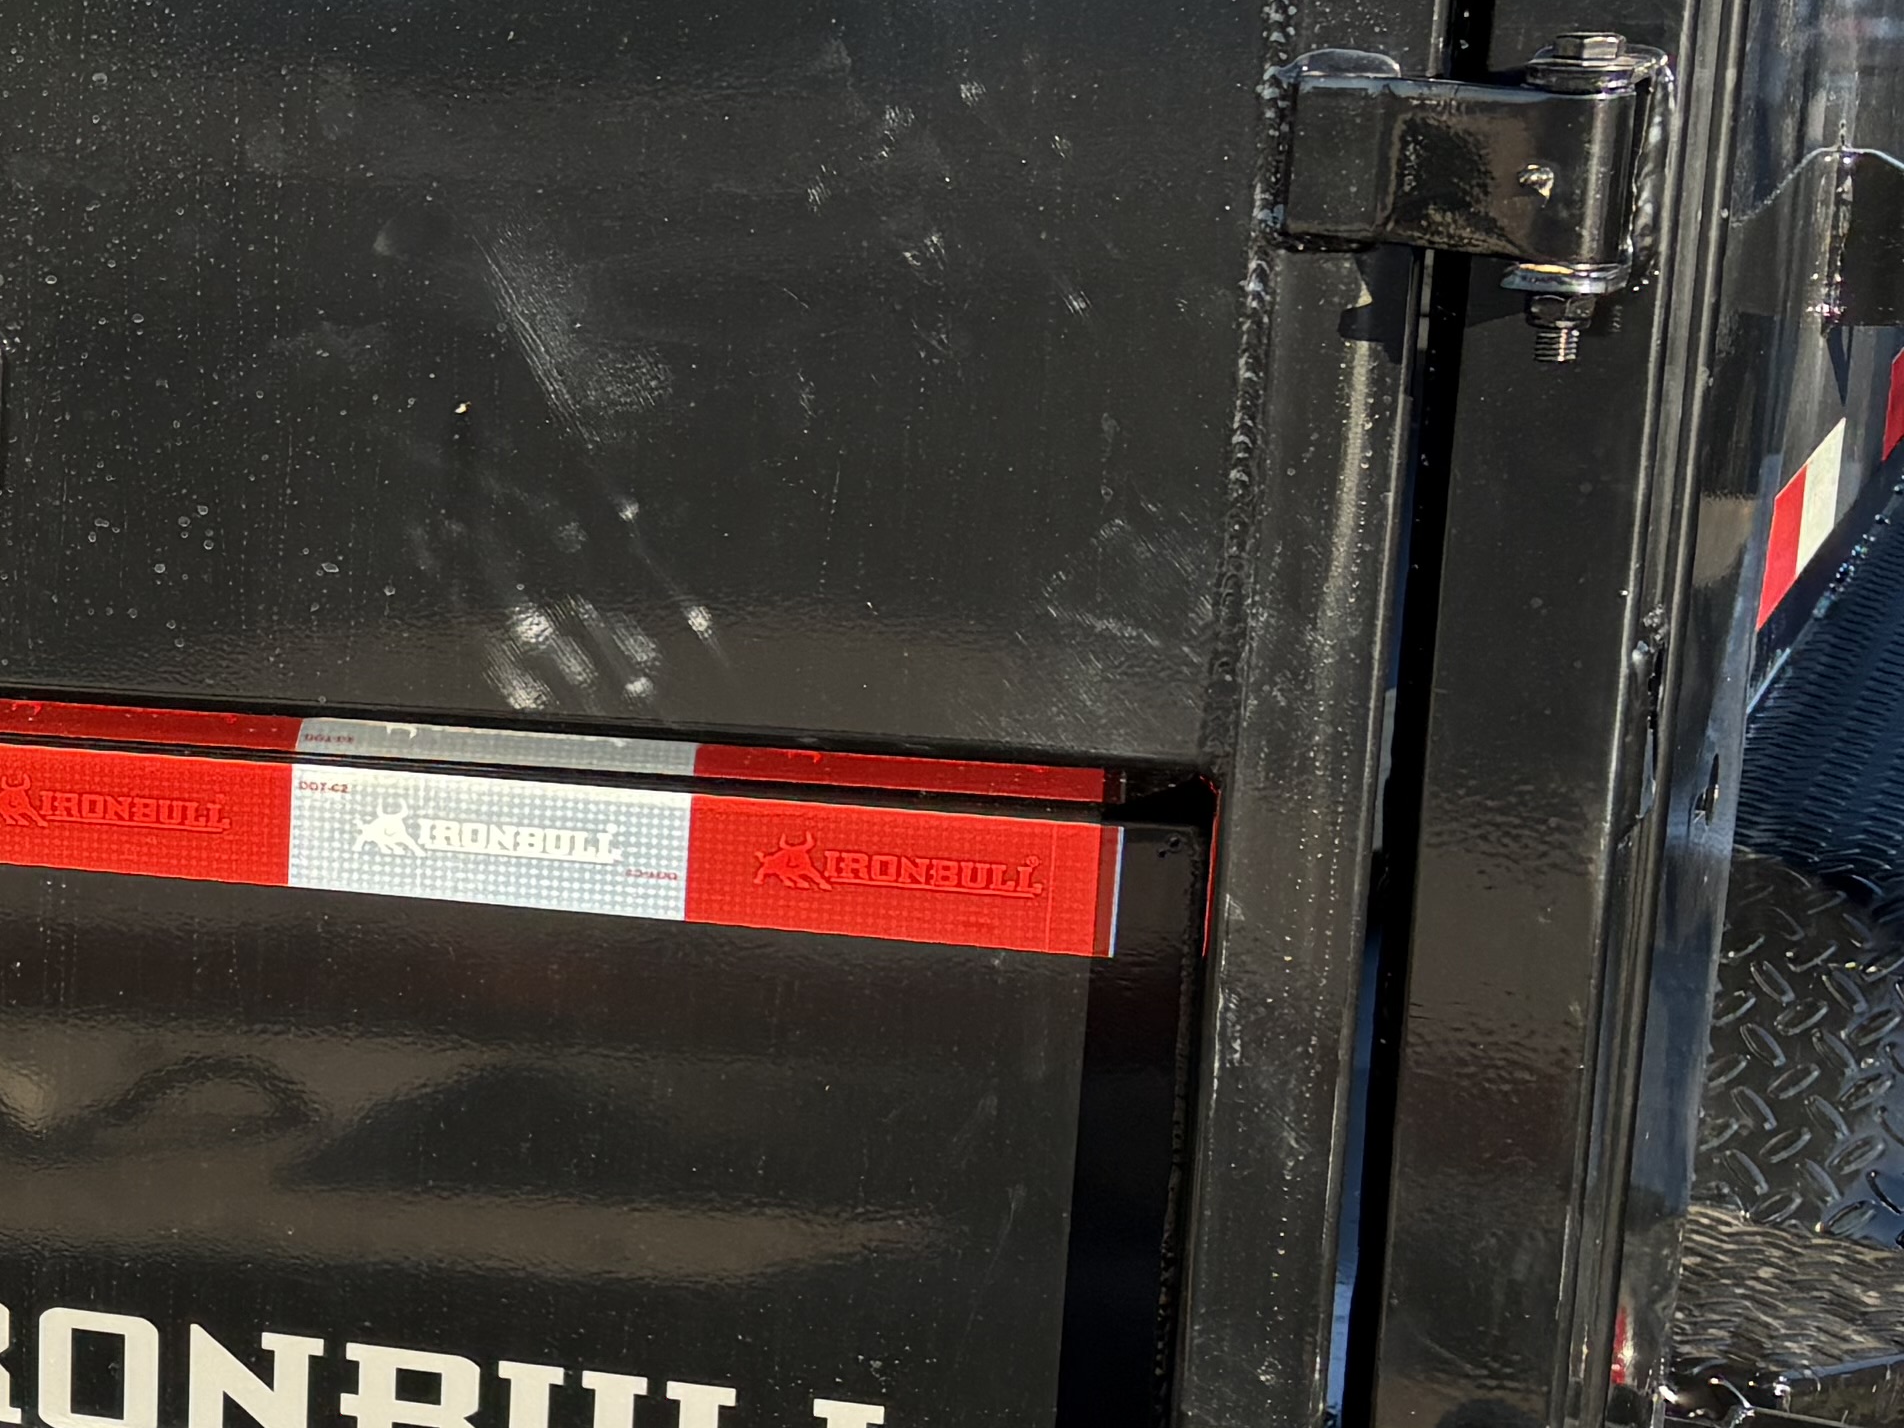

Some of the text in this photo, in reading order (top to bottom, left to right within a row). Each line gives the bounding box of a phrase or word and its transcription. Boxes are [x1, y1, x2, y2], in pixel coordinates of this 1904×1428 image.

[298, 779, 351, 794] DOT-C2
[40, 790, 231, 829] IRONBULL
[417, 817, 624, 863] IRONBULL
[823, 849, 1044, 895] IRONBULL
